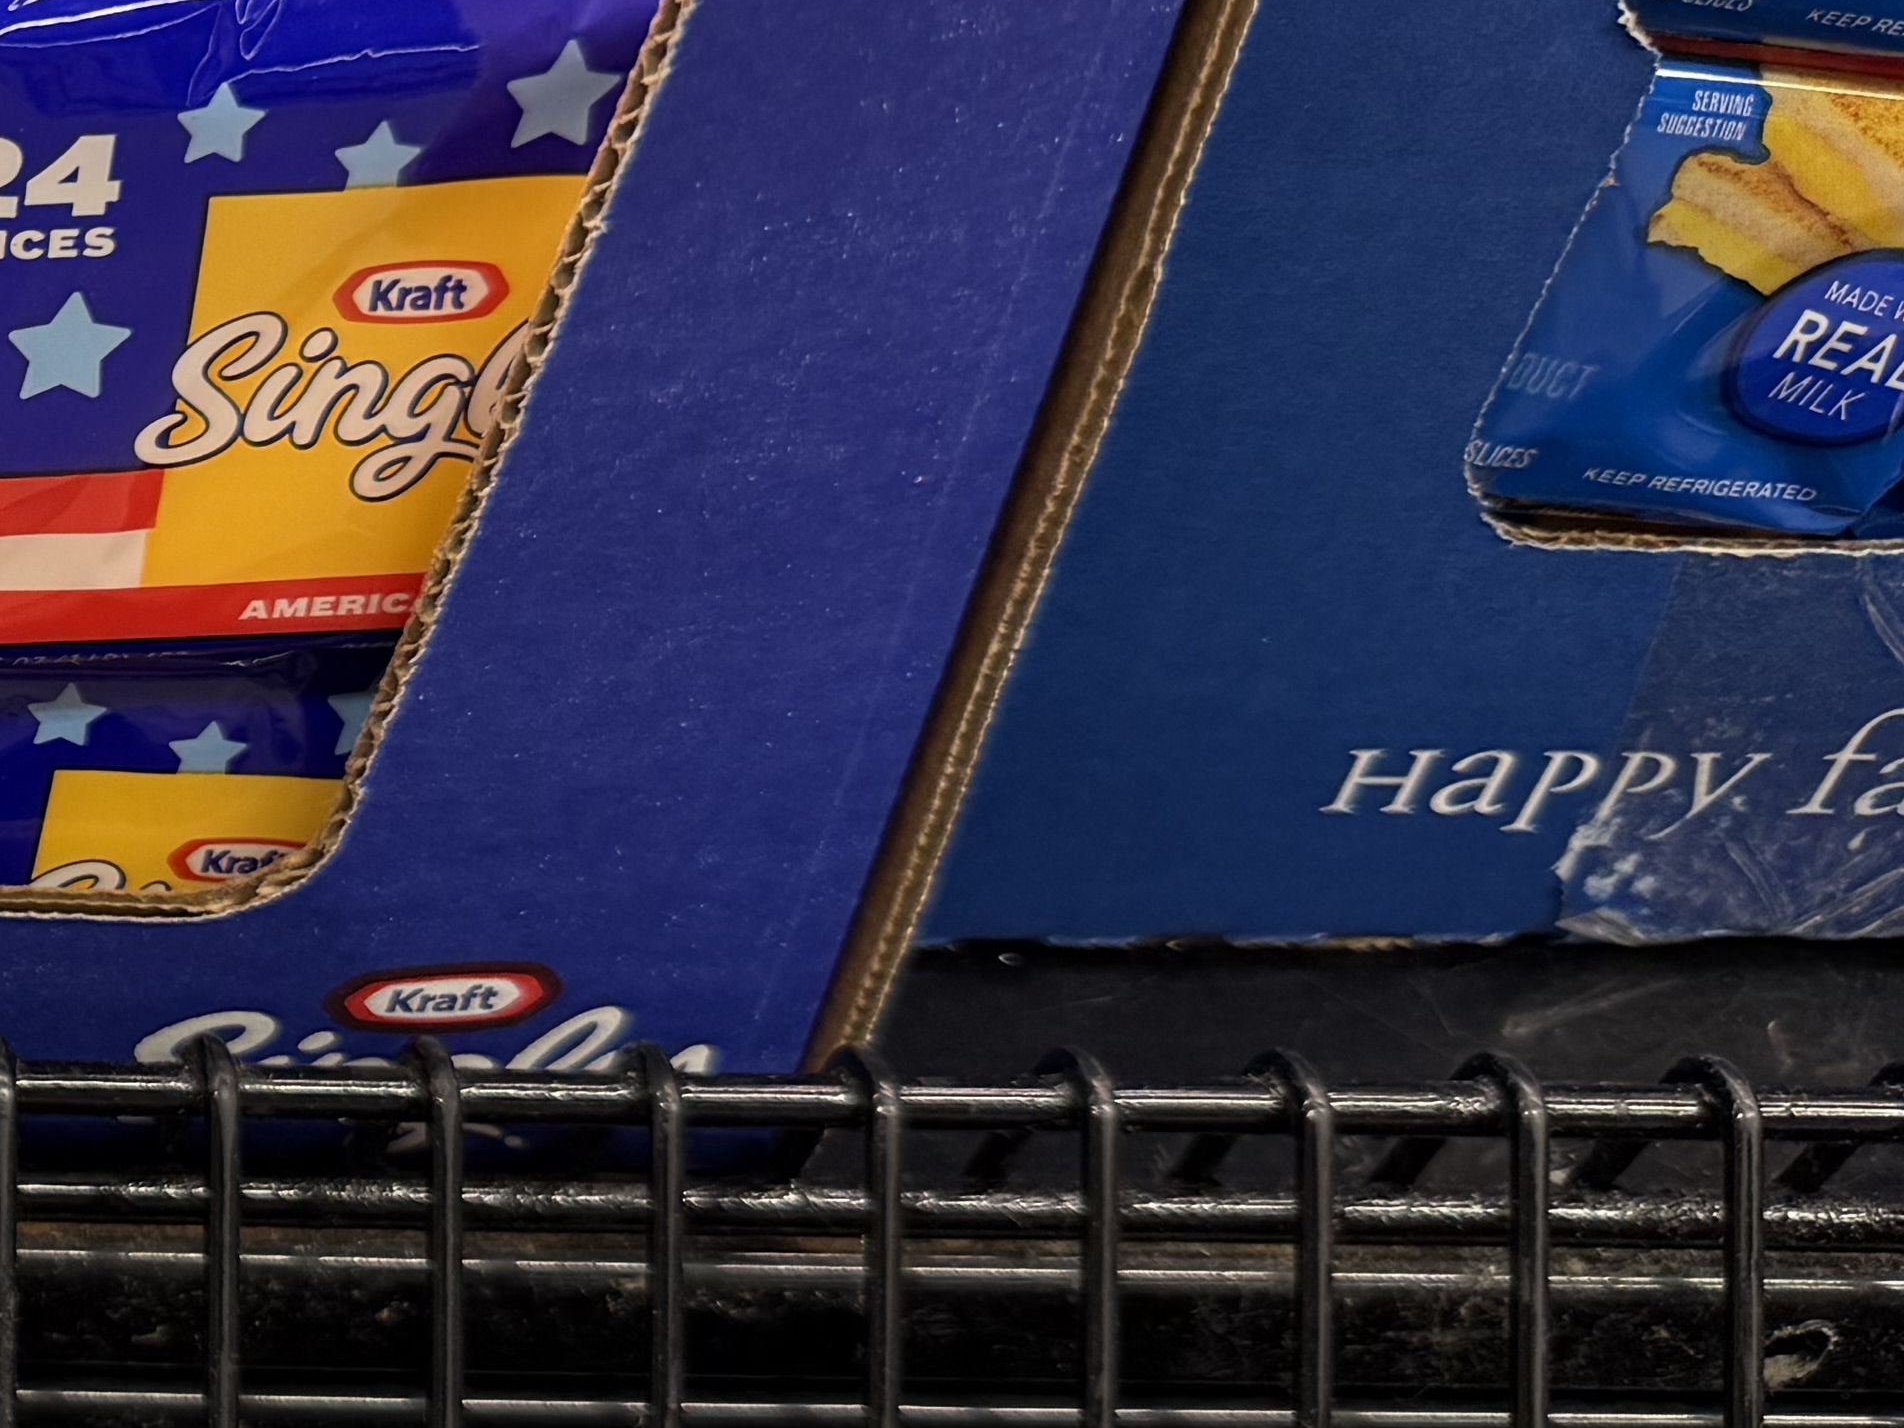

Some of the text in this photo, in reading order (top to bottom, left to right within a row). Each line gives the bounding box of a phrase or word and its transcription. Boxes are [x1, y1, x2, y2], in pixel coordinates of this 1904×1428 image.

[1806, 9, 1871, 29] KEEP
[1692, 90, 1754, 117] SERVING
[1656, 113, 1748, 141] SUGGESTION
[368, 270, 468, 313] Kraft
[1824, 279, 1894, 318] MADE
[1768, 371, 1866, 422] MILK
[1465, 439, 1539, 470] SLICES
[1583, 468, 1817, 503] KEEP REFRIGERATED
[1319, 747, 1772, 847] Happy
[384, 983, 500, 1016] Kraft
